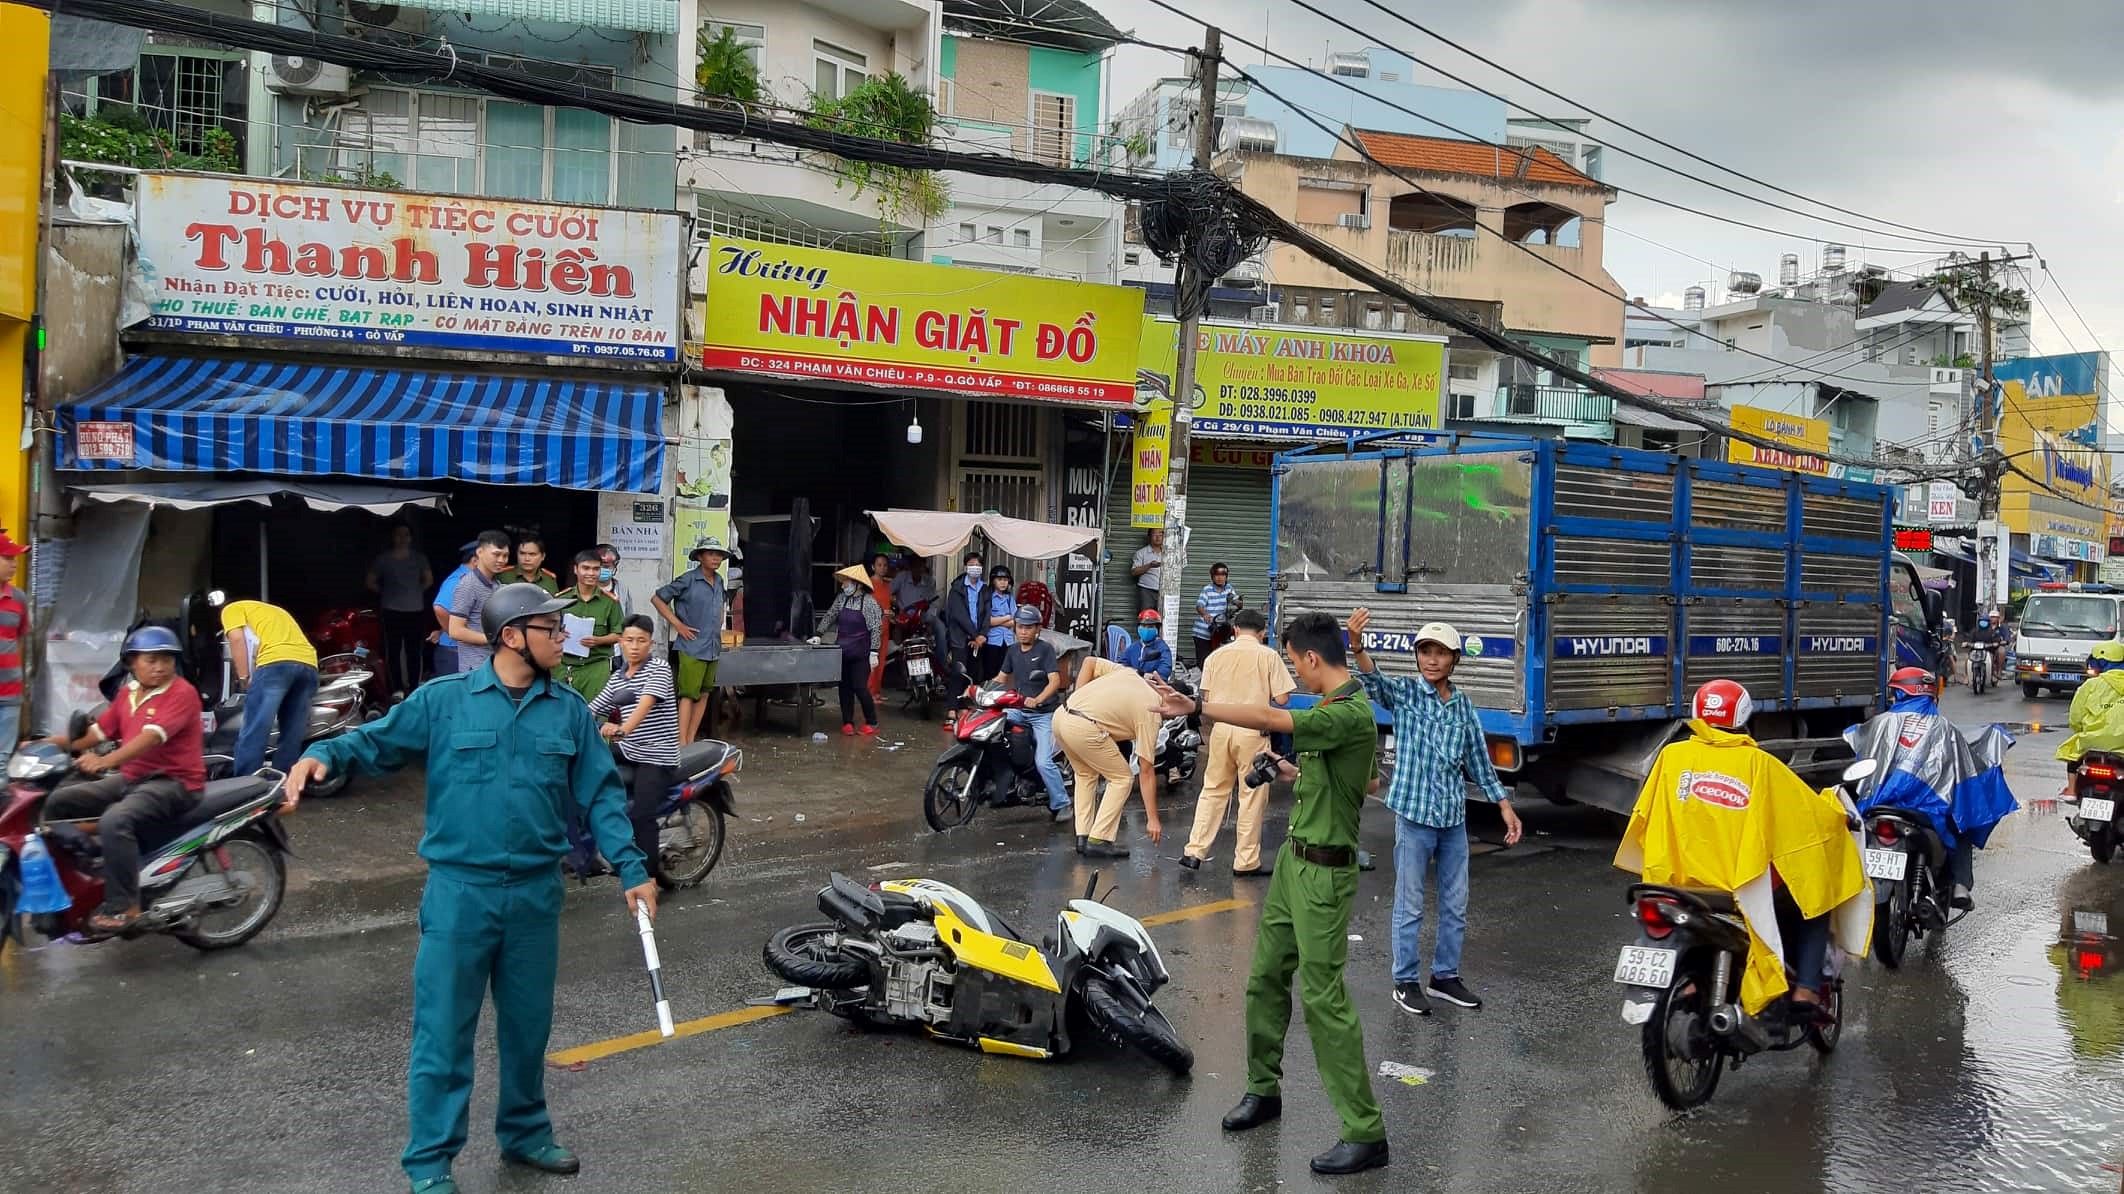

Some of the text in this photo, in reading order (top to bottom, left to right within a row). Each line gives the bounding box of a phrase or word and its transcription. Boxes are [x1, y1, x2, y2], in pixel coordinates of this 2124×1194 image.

[228, 191, 599, 241] DỊCH VỤ TIỆC CƯỚI
[184, 222, 636, 298] Thanh Hiền
[718, 246, 829, 290] Hưng
[165, 277, 653, 324] Nhận Đặt Tiệc: CƯỚI, HỎI, LIÊN HOAN, SINH NHẬT
[159, 299, 184, 313] HO
[559, 320, 602, 339] TRÊN
[608, 327, 626, 341] 10
[632, 328, 667, 343] BÀN
[187, 320, 220, 332] PHẠM
[224, 320, 245, 332] VĂN
[248, 320, 284, 334] CHIÊU
[294, 324, 340, 338] PHƯỜNG
[340, 329, 354, 338] 14
[366, 328, 381, 340] GÒ
[384, 327, 405, 341] VẤP
[759, 291, 1098, 364] NHẬN GIẶT ĐỒ
[572, 344, 666, 358] ĐT: 0937.05.76.05
[1215, 330, 1270, 357] MÁY
[1272, 338, 1326, 360] ANH
[1330, 341, 1396, 364] KHOA
[741, 356, 764, 368] ĐC:
[768, 358, 790, 370] 324
[794, 361, 832, 374] PHẠM
[836, 363, 862, 376] VĂN
[866, 366, 906, 380] CHIÊU
[916, 372, 934, 384] P.9
[944, 374, 976, 388] Q.GÒ
[979, 376, 1002, 388] VẤP
[1038, 384, 1074, 394] 086868
[1078, 386, 1090, 396] 55
[1093, 388, 1105, 397] 19
[1266, 362, 1285, 382] Mua
[1287, 364, 1304, 382] Bán
[1306, 367, 1326, 385] Trao
[1328, 365, 1344, 386] Đổi
[1346, 368, 1362, 388] Các
[1363, 370, 1382, 389] Loại
[1384, 372, 1395, 388] Xe
[1396, 374, 1410, 392] Ga,
[1412, 376, 1425, 391] Xe
[1426, 372, 1438, 392] Số
[1220, 385, 1316, 404] ĐT: 028.3996.0399
[1218, 402, 1432, 429] DĐ: 0938.021.085 0908.427.947 (A.TUẤN)
[1776, 418, 1796, 436] BÁNH
[1138, 444, 1162, 473] NHẬN
[1135, 474, 1166, 508] GIẶT ĐỒ
[1930, 501, 1954, 515] KEN
[1572, 637, 1650, 656] HYUNDAI
[1716, 637, 1760, 653] 60C-274.16
[1810, 636, 1865, 652] HYUNDAI
[1628, 950, 1668, 968] 59-C2
[1620, 965, 1668, 984] 086.60
